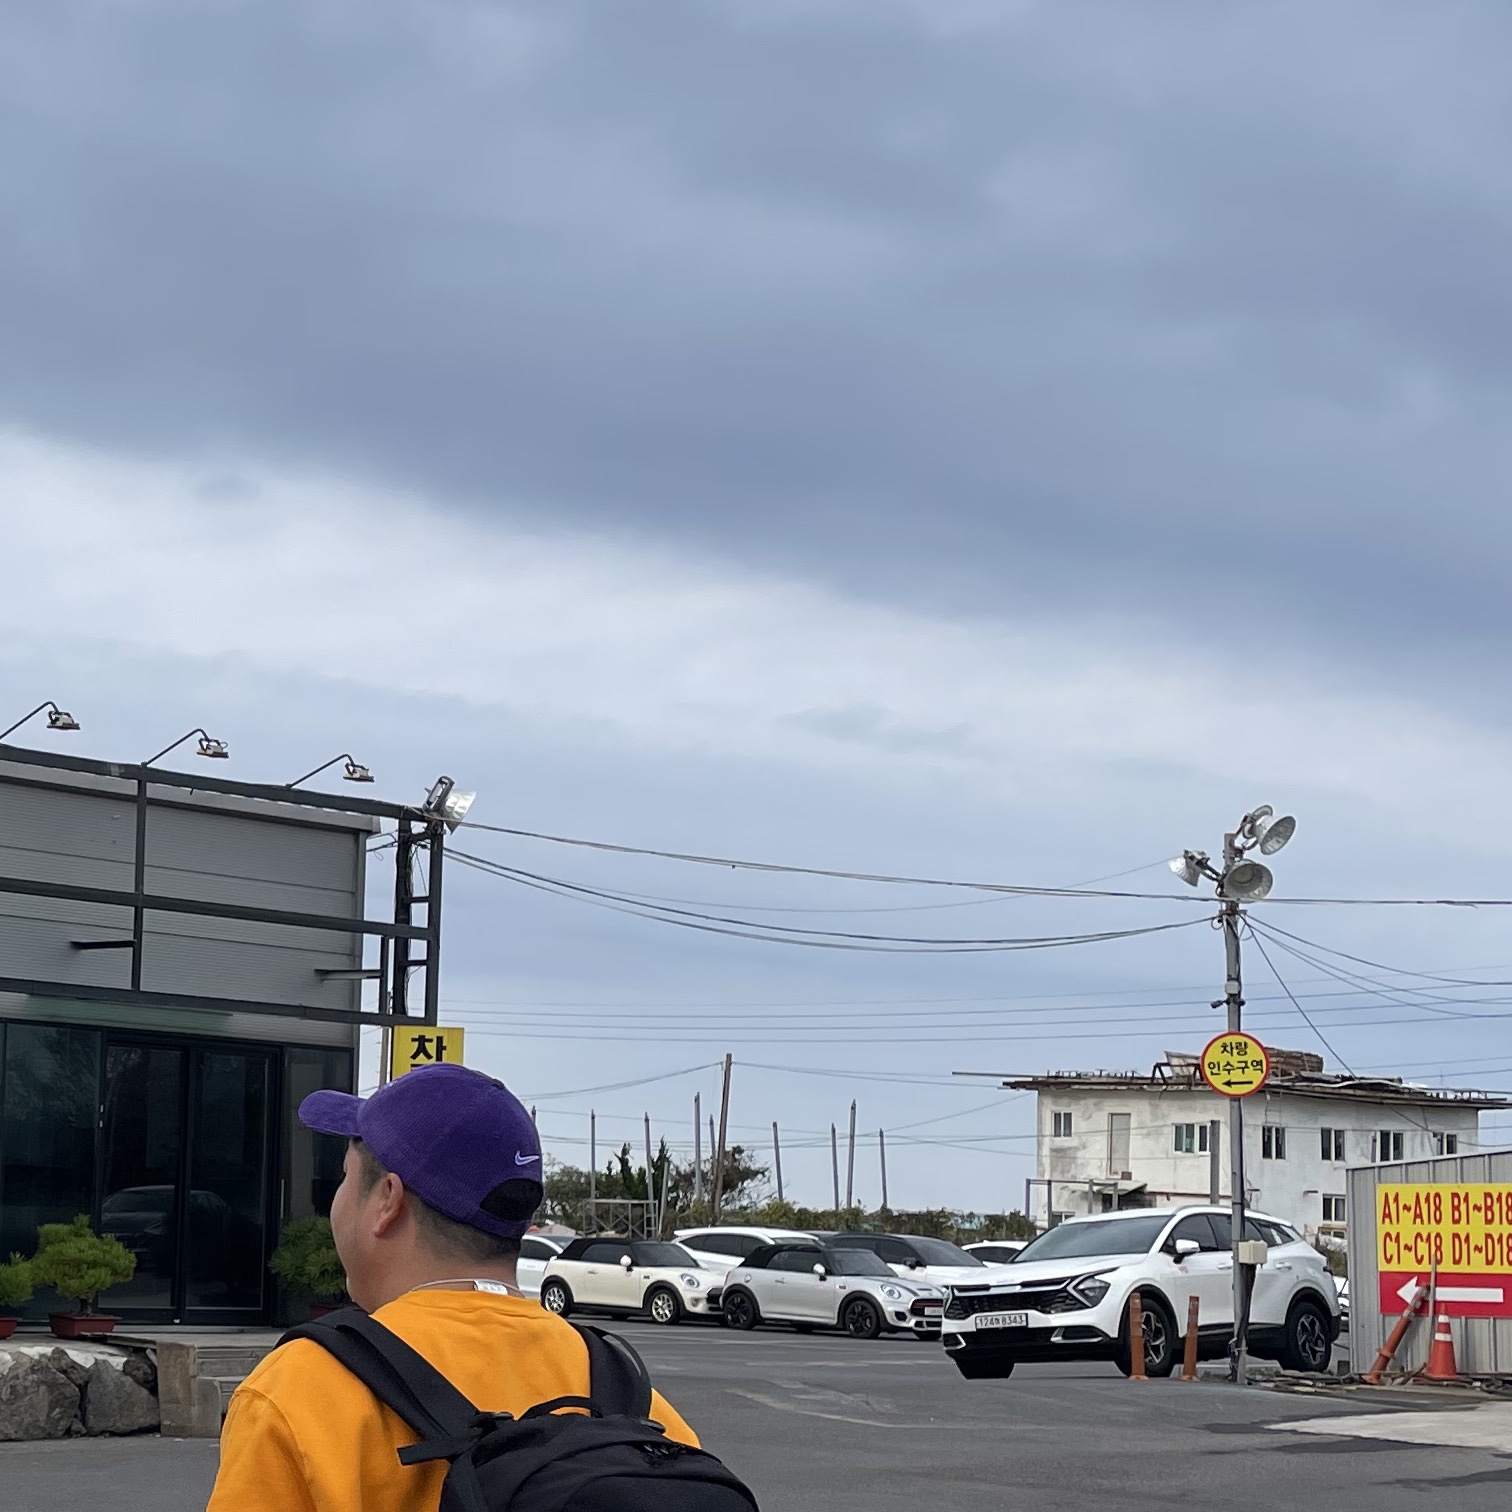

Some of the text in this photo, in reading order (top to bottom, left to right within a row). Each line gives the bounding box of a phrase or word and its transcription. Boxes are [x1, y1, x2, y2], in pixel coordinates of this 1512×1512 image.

[1221, 1041, 1248, 1057] 차량
[1208, 1059, 1264, 1076] 인수구역
[1381, 1191, 1512, 1225] A1~A18 B1~B18
[1383, 1232, 1512, 1267] C1~C18 D1~D18
